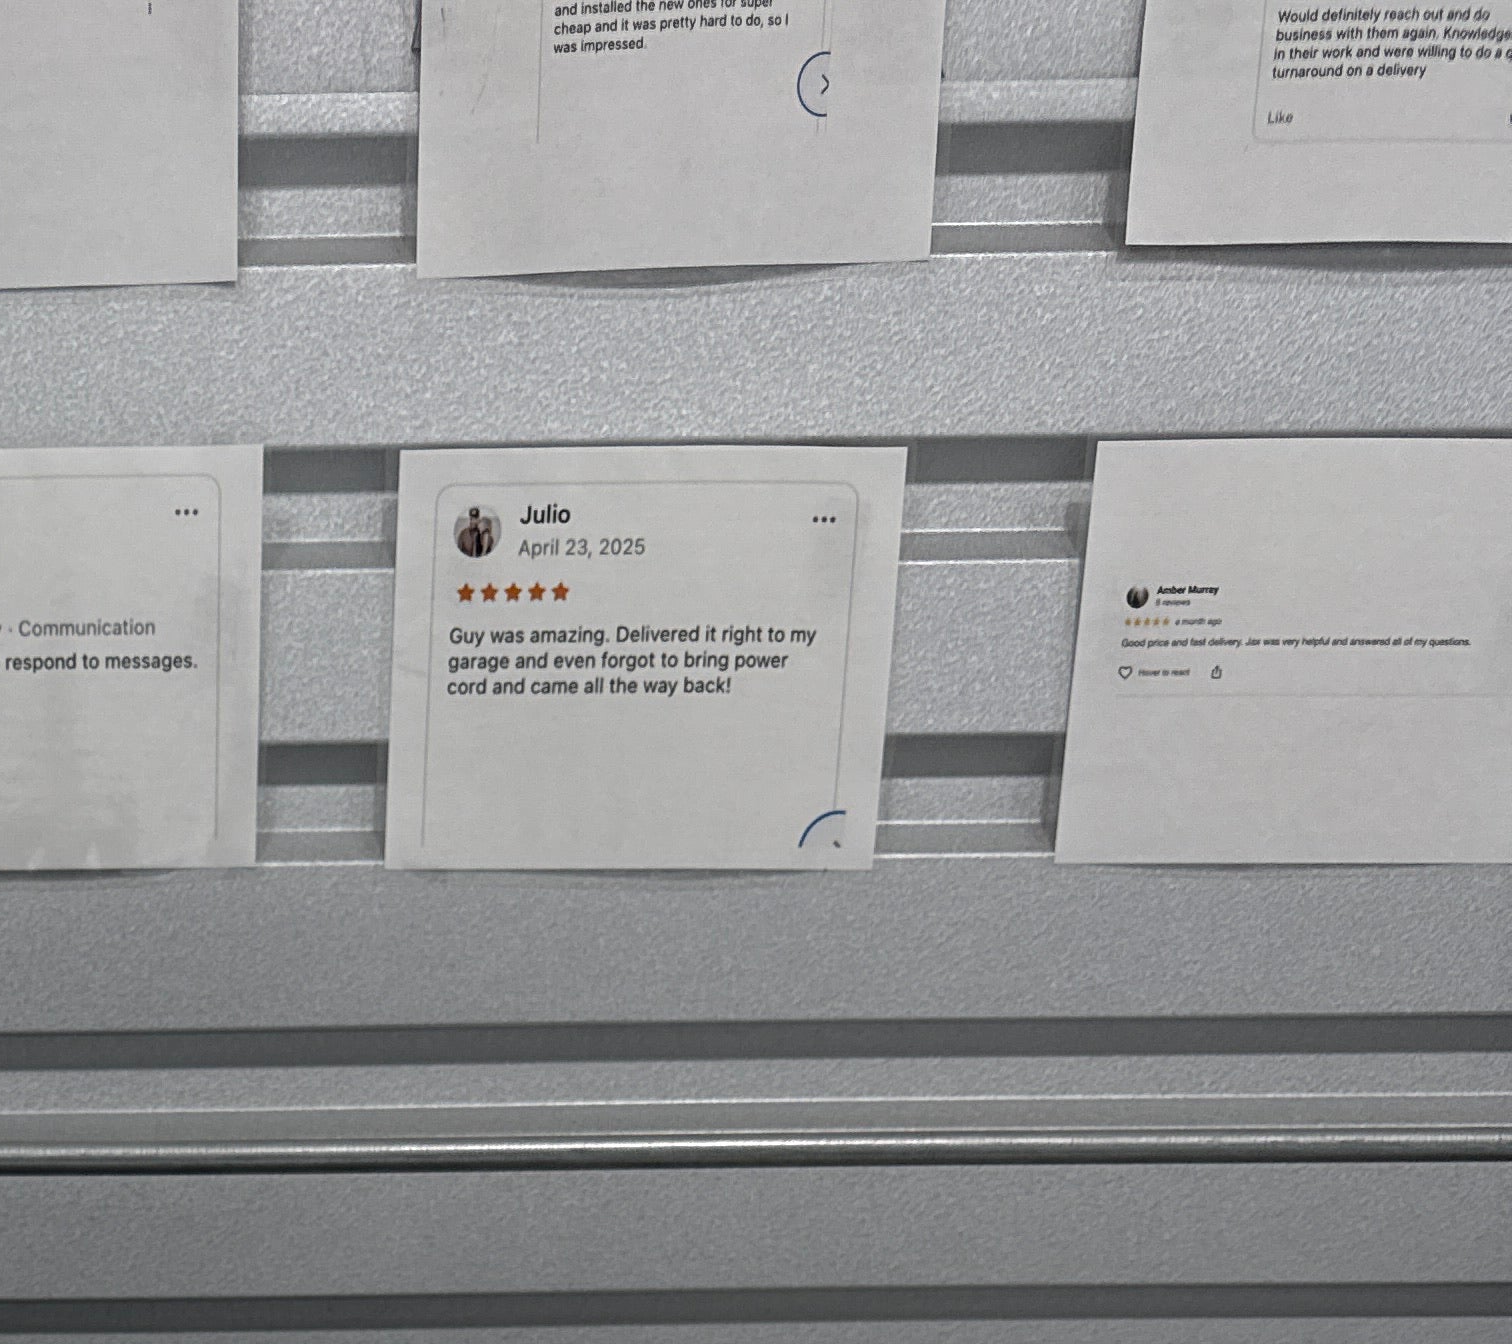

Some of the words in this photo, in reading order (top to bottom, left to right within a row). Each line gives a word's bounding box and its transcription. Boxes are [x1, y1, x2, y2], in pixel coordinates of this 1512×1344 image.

[553, 22, 592, 35] cheap
[594, 20, 618, 33] and
[621, 19, 629, 31] it
[632, 20, 656, 31] was
[659, 17, 696, 32] pretty
[699, 16, 727, 27] hard
[730, 16, 742, 27] to
[745, 15, 763, 28] do,
[767, 16, 782, 26] so
[785, 14, 789, 26] I
[1278, 9, 1319, 23] Would
[1321, 8, 1381, 24] definitely
[1383, 8, 1420, 21] reach
[1422, 8, 1444, 21] out
[1446, 8, 1471, 21] and
[1473, 8, 1490, 21] do
[1275, 28, 1332, 41] business
[1336, 27, 1363, 40] with
[1366, 27, 1399, 39] them
[553, 42, 578, 54] was
[1272, 64, 1343, 79] turnaround
[1346, 66, 1362, 77] on
[1365, 66, 1374, 76] a
[1376, 63, 1427, 79] delivery
[1267, 111, 1294, 124] Like
[519, 503, 571, 524] Julio
[518, 538, 559, 560] April
[565, 538, 592, 559] 23,
[599, 537, 645, 555] 2025
[1156, 586, 1186, 594] Amber
[1187, 585, 1219, 596] Murray
[18, 618, 155, 637] Communication
[449, 627, 485, 648] Guy
[490, 630, 524, 644] was
[529, 626, 610, 647] amazing.
[616, 625, 700, 643] Delivered
[705, 625, 716, 642] it
[721, 625, 762, 646] right
[767, 627, 785, 643] to
[790, 629, 817, 647] my
[5, 653, 77, 673] respond
[82, 654, 100, 670] to
[105, 655, 197, 672] messages.
[448, 655, 510, 673] garage
[515, 652, 548, 669] and
[553, 655, 596, 669] even
[601, 651, 655, 672] forgot
[661, 652, 679, 668] to
[684, 651, 729, 672] bring
[734, 654, 789, 671] power
[446, 677, 487, 695] cord
[492, 677, 526, 695] and
[530, 681, 578, 695] came
[583, 677, 604, 694] all
[609, 676, 638, 694] the
[643, 680, 678, 697] way
[683, 676, 731, 693] back!
